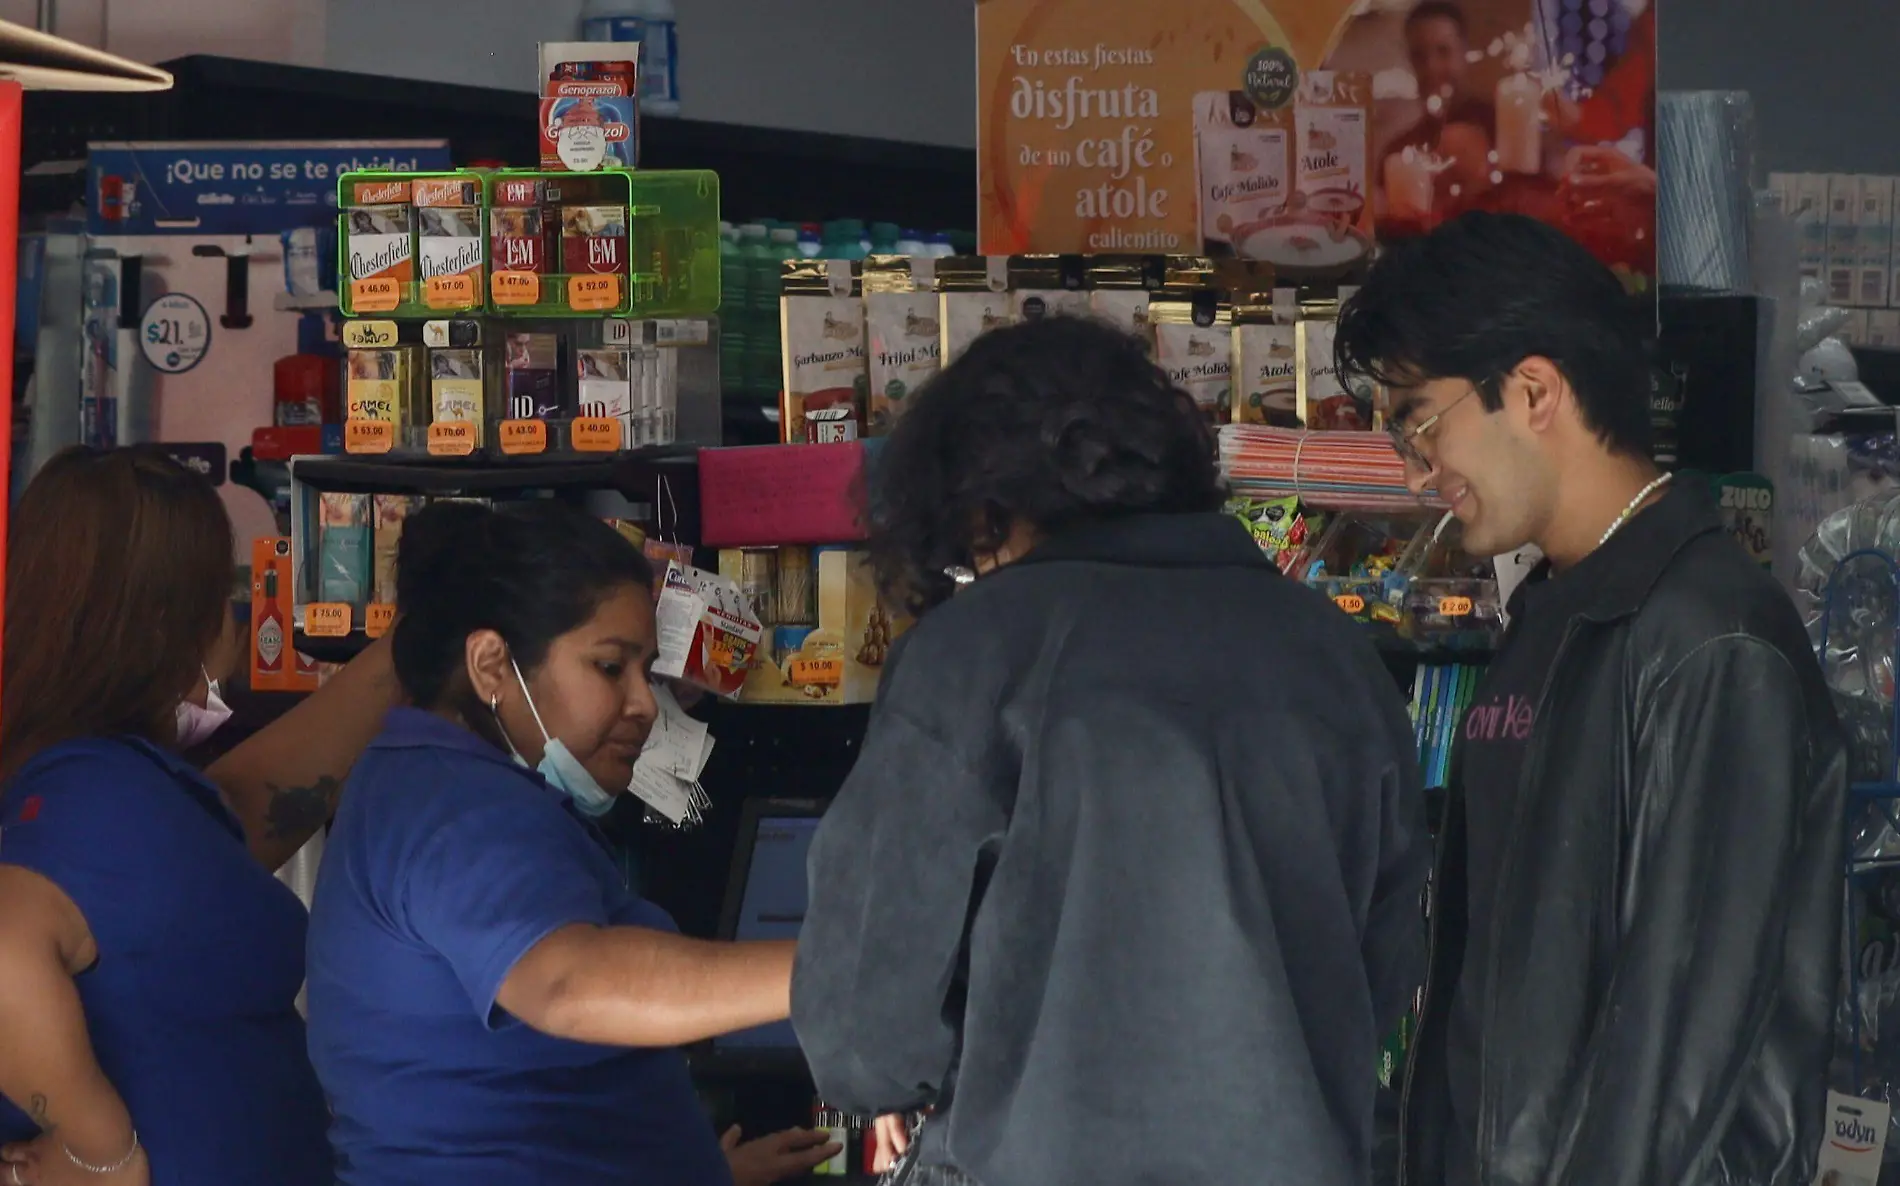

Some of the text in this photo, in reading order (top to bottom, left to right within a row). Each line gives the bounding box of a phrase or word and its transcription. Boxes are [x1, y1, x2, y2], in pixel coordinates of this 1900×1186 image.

[1010, 43, 1153, 70] En estas fiestas
[560, 84, 617, 97] Genoprazol
[1011, 76, 1160, 129] disfruta
[1019, 124, 1173, 180] de un café o
[1301, 151, 1339, 172] Atole
[167, 159, 224, 184] ¡Que
[232, 162, 263, 180] no
[269, 162, 297, 180] se
[304, 159, 329, 180] te
[362, 182, 403, 204] Chesterfield
[416, 180, 462, 207] Chesterfield
[1075, 176, 1169, 218] atole
[1088, 227, 1180, 250] calientito
[350, 235, 410, 281] Chesterfield
[420, 239, 481, 282] Chesterfield
[505, 238, 534, 266] L&M
[588, 238, 617, 265] L&M
[794, 350, 845, 371] Garbanzo
[878, 350, 916, 368] Frijol
[1259, 363, 1294, 379] Atole
[350, 399, 392, 413] CAMEL
[437, 399, 478, 413] CAMEL
[1719, 484, 1772, 509] ZUKO
